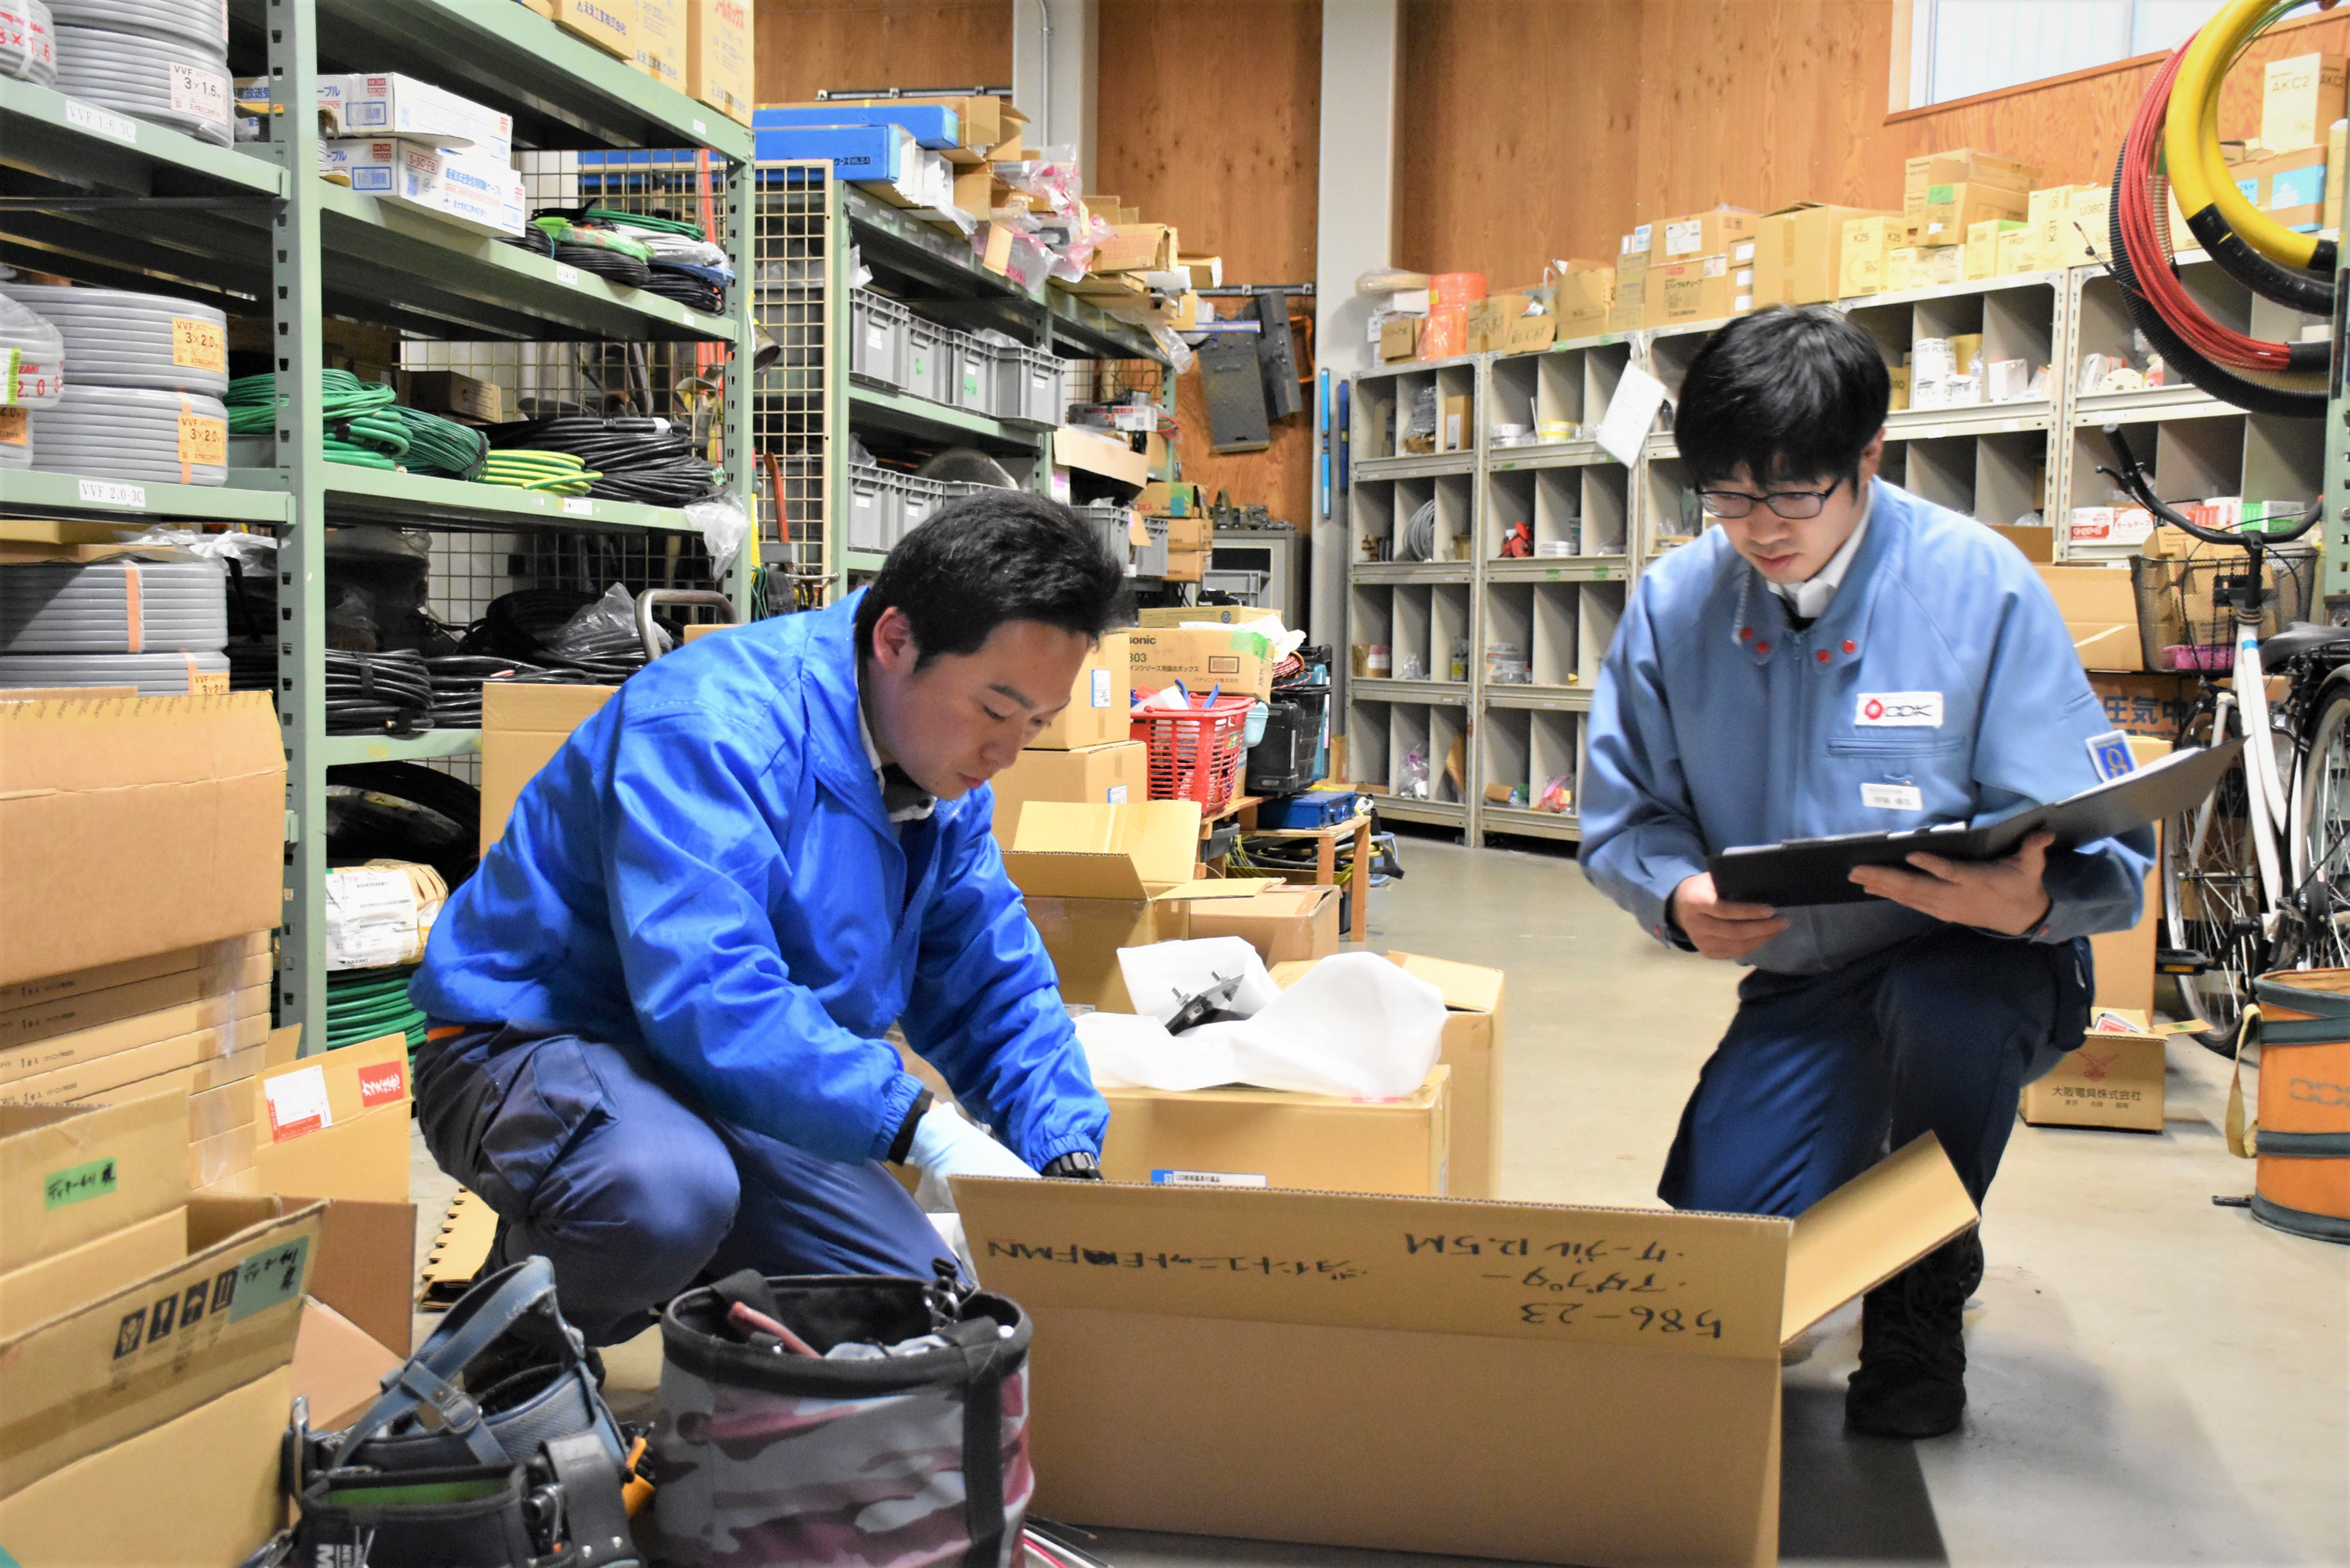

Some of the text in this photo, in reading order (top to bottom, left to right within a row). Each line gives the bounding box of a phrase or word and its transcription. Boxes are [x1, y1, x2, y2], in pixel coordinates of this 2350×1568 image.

[174, 64, 192, 76] VVF
[69, 105, 132, 138] VVF 1.6-3C
[1853, 233, 1870, 243] K25
[1887, 232, 1902, 243] K25
[176, 320, 193, 331] VVF
[181, 418, 198, 427] VVF
[82, 483, 144, 503] VVF 2.0-3C
[1520, 1303, 1721, 1338] 586-23
